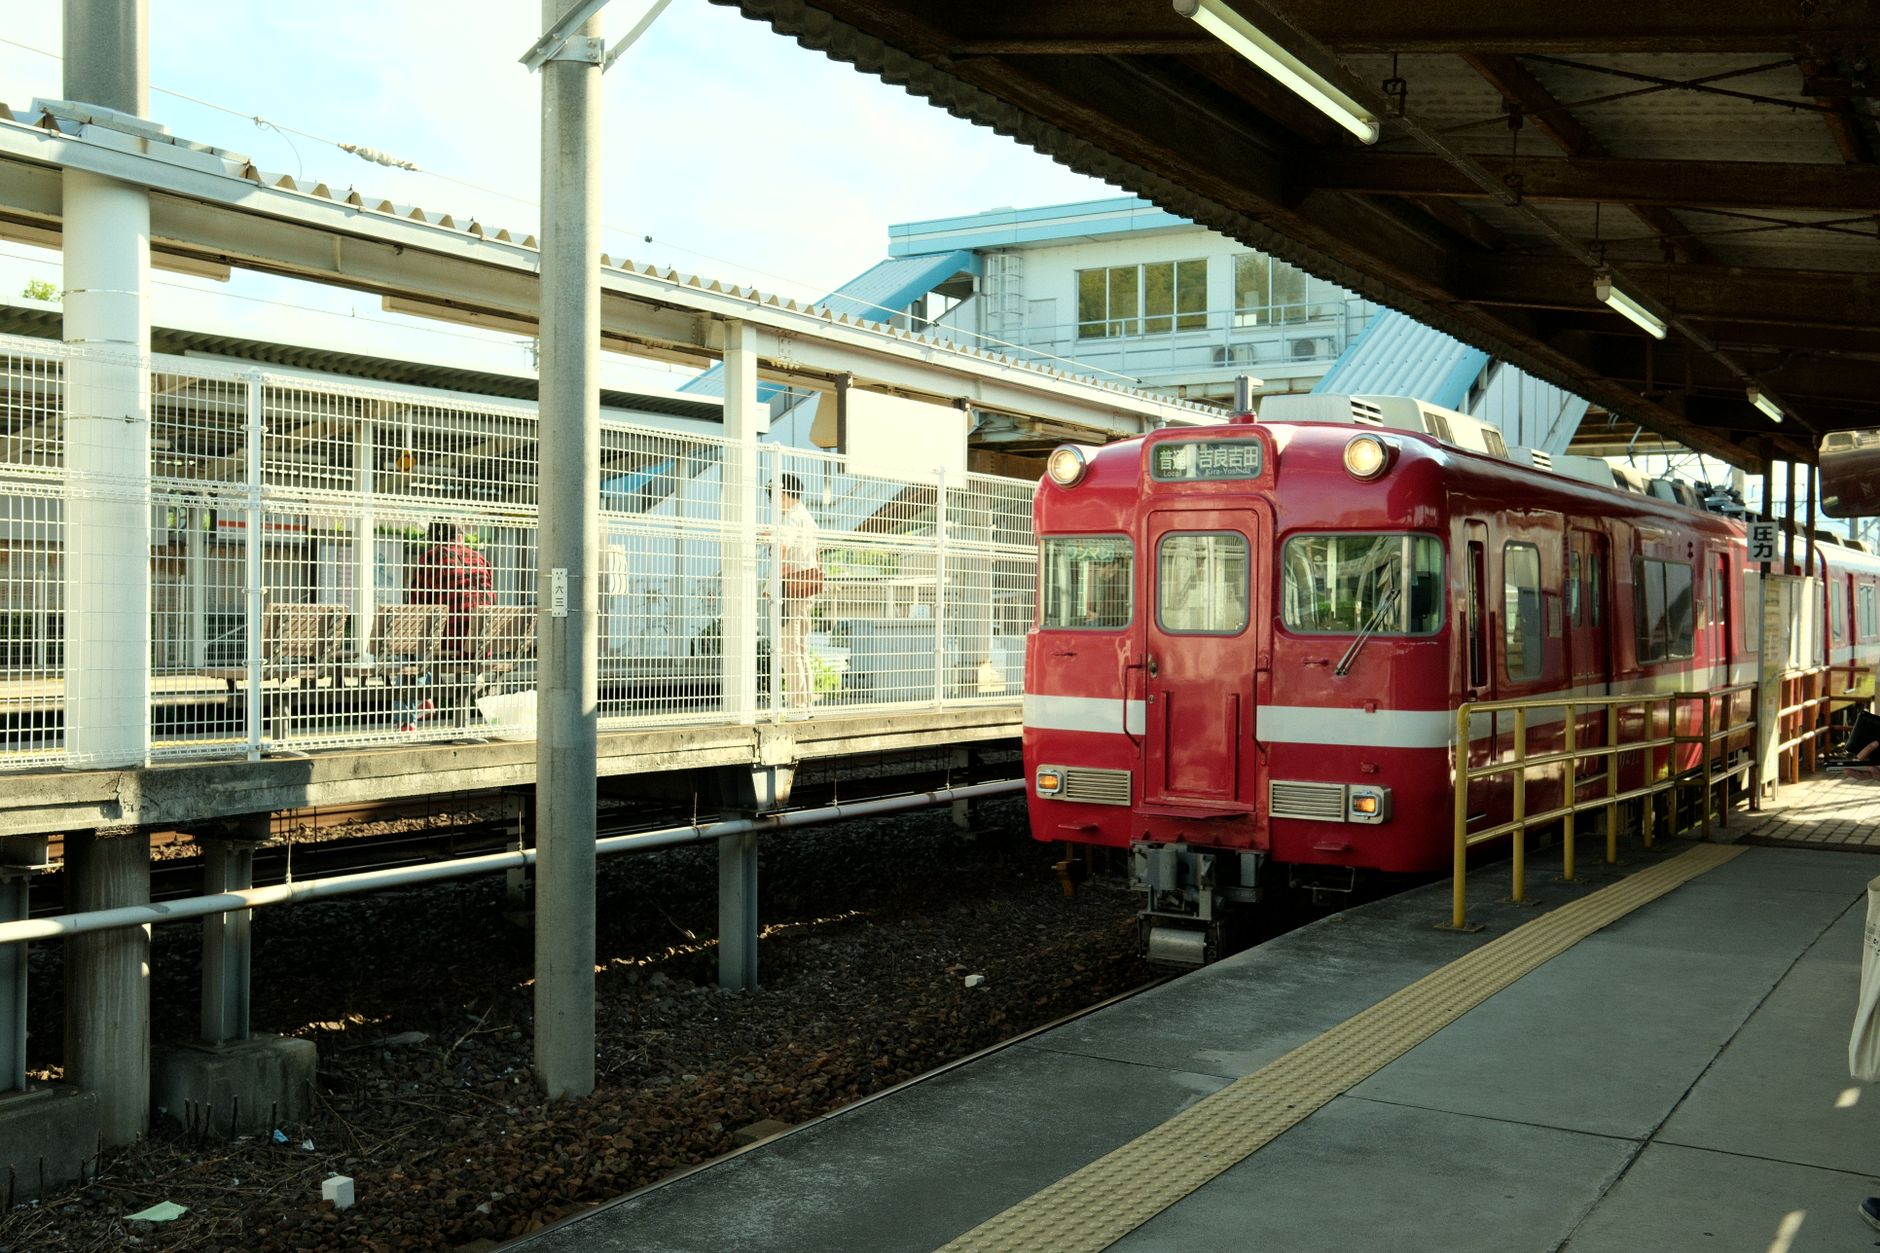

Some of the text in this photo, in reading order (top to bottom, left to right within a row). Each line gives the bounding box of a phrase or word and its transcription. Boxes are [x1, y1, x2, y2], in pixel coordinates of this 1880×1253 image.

[1160, 449, 1186, 470] 普通
[1199, 446, 1258, 468] 吉良吉田
[1753, 526, 1773, 558] 圧力
[555, 585, 564, 606] 六三
